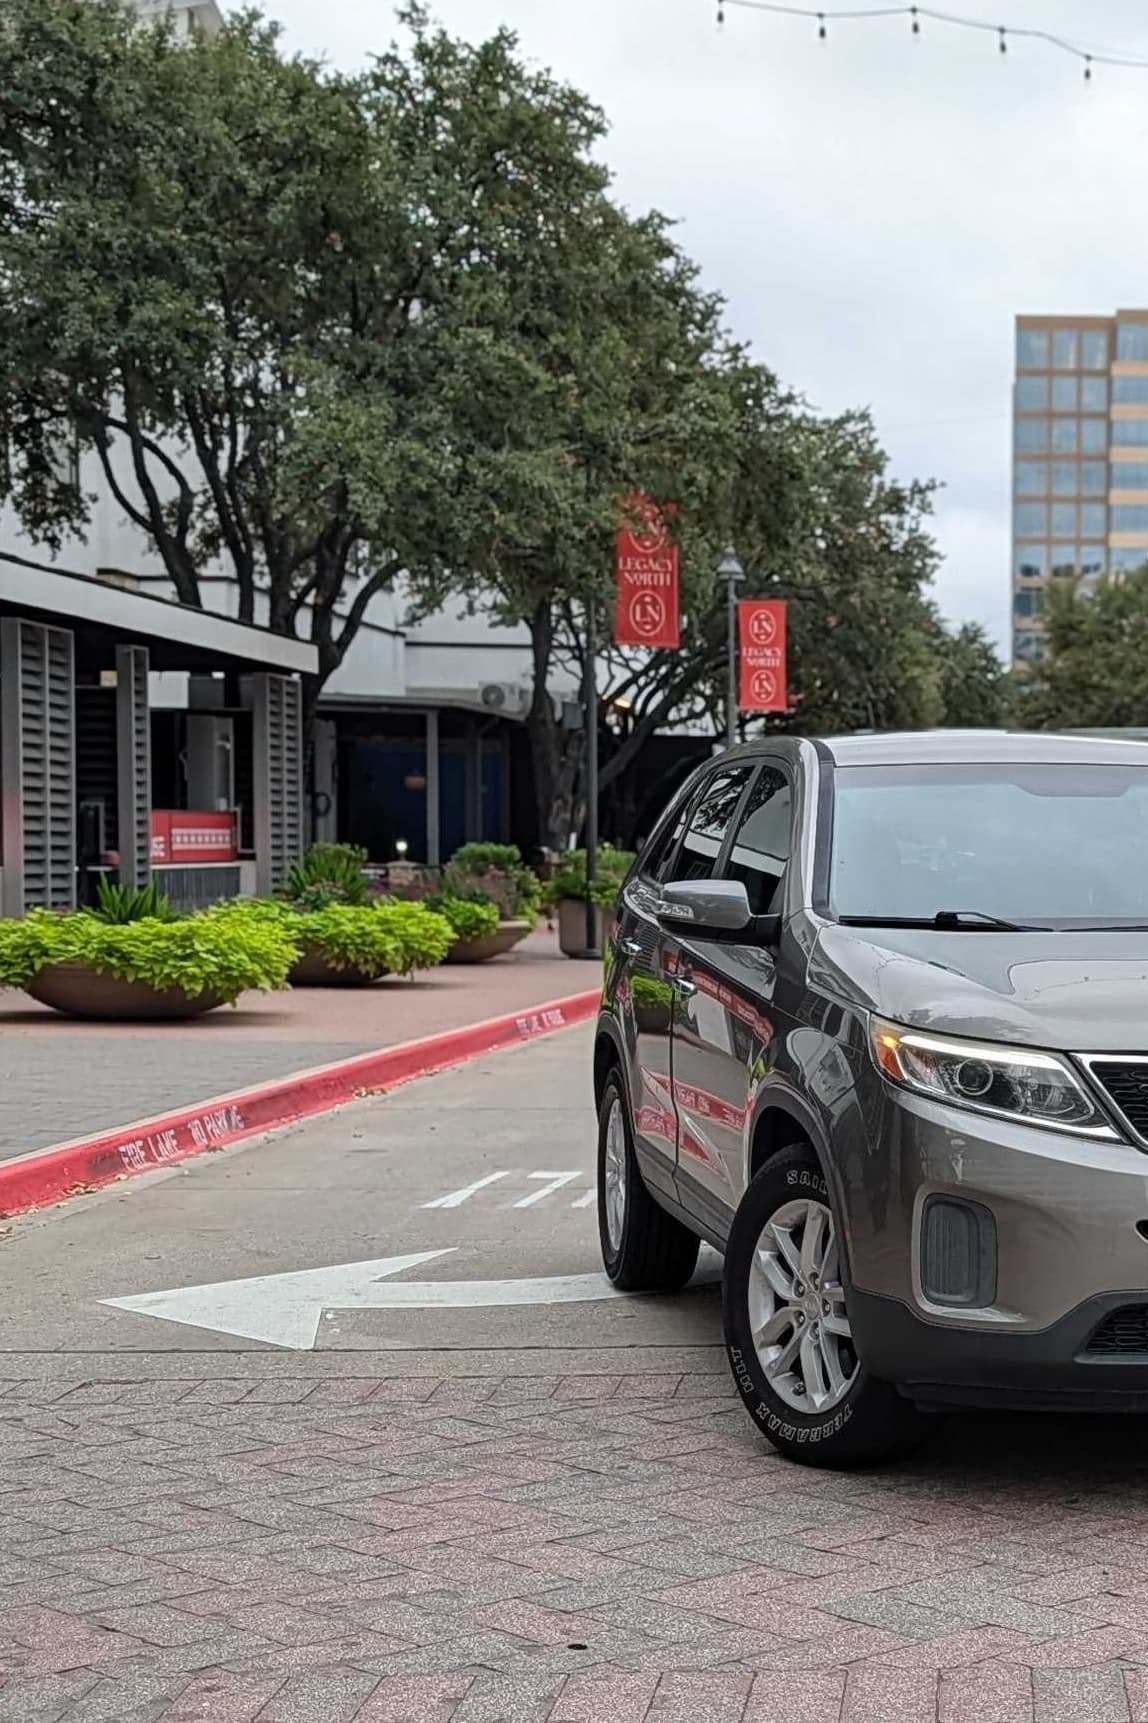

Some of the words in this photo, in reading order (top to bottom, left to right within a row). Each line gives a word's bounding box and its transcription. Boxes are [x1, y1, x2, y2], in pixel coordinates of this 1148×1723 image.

[618, 556, 673, 572] LEGACY
[624, 571, 671, 587] NORTH
[635, 603, 661, 623] LN
[118, 1140, 146, 1173] FIRE
[148, 1129, 181, 1163] LANE
[786, 1169, 828, 1194] SAIL
